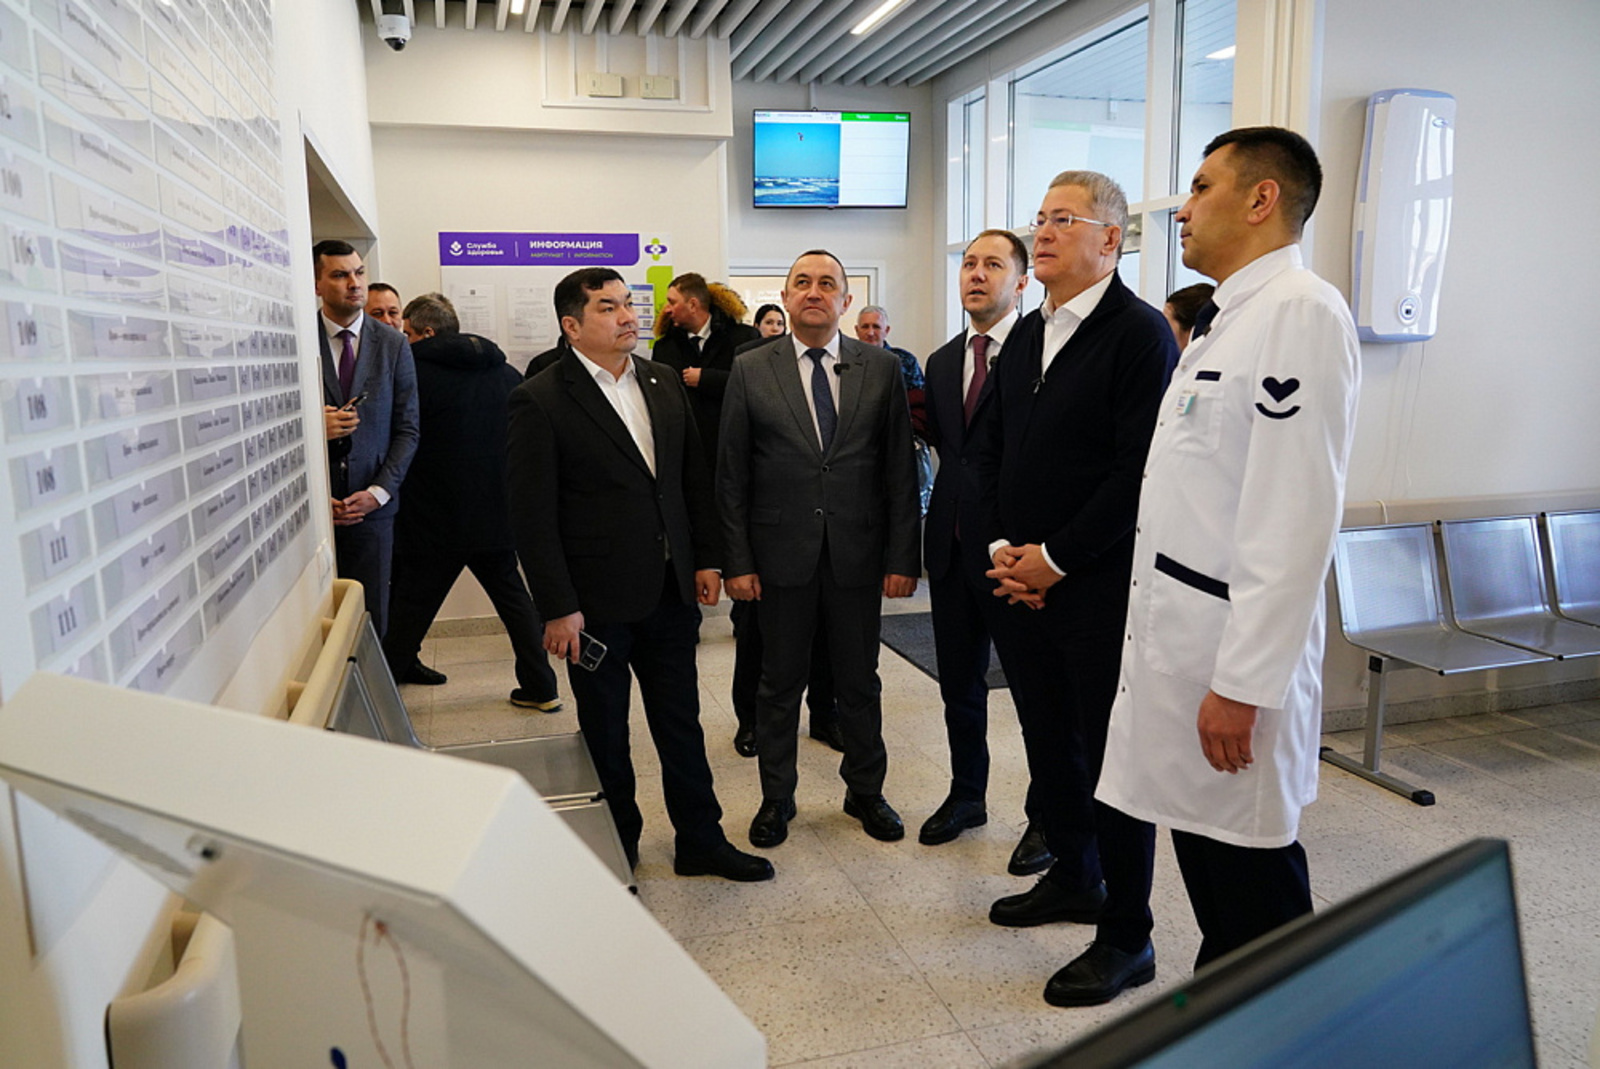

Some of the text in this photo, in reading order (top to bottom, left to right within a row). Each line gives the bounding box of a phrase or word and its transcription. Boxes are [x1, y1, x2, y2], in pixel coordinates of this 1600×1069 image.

[466, 242, 497, 251] Служба
[529, 241, 603, 250] ИНФОРМАЦИЯ
[466, 249, 504, 257] здоровья
